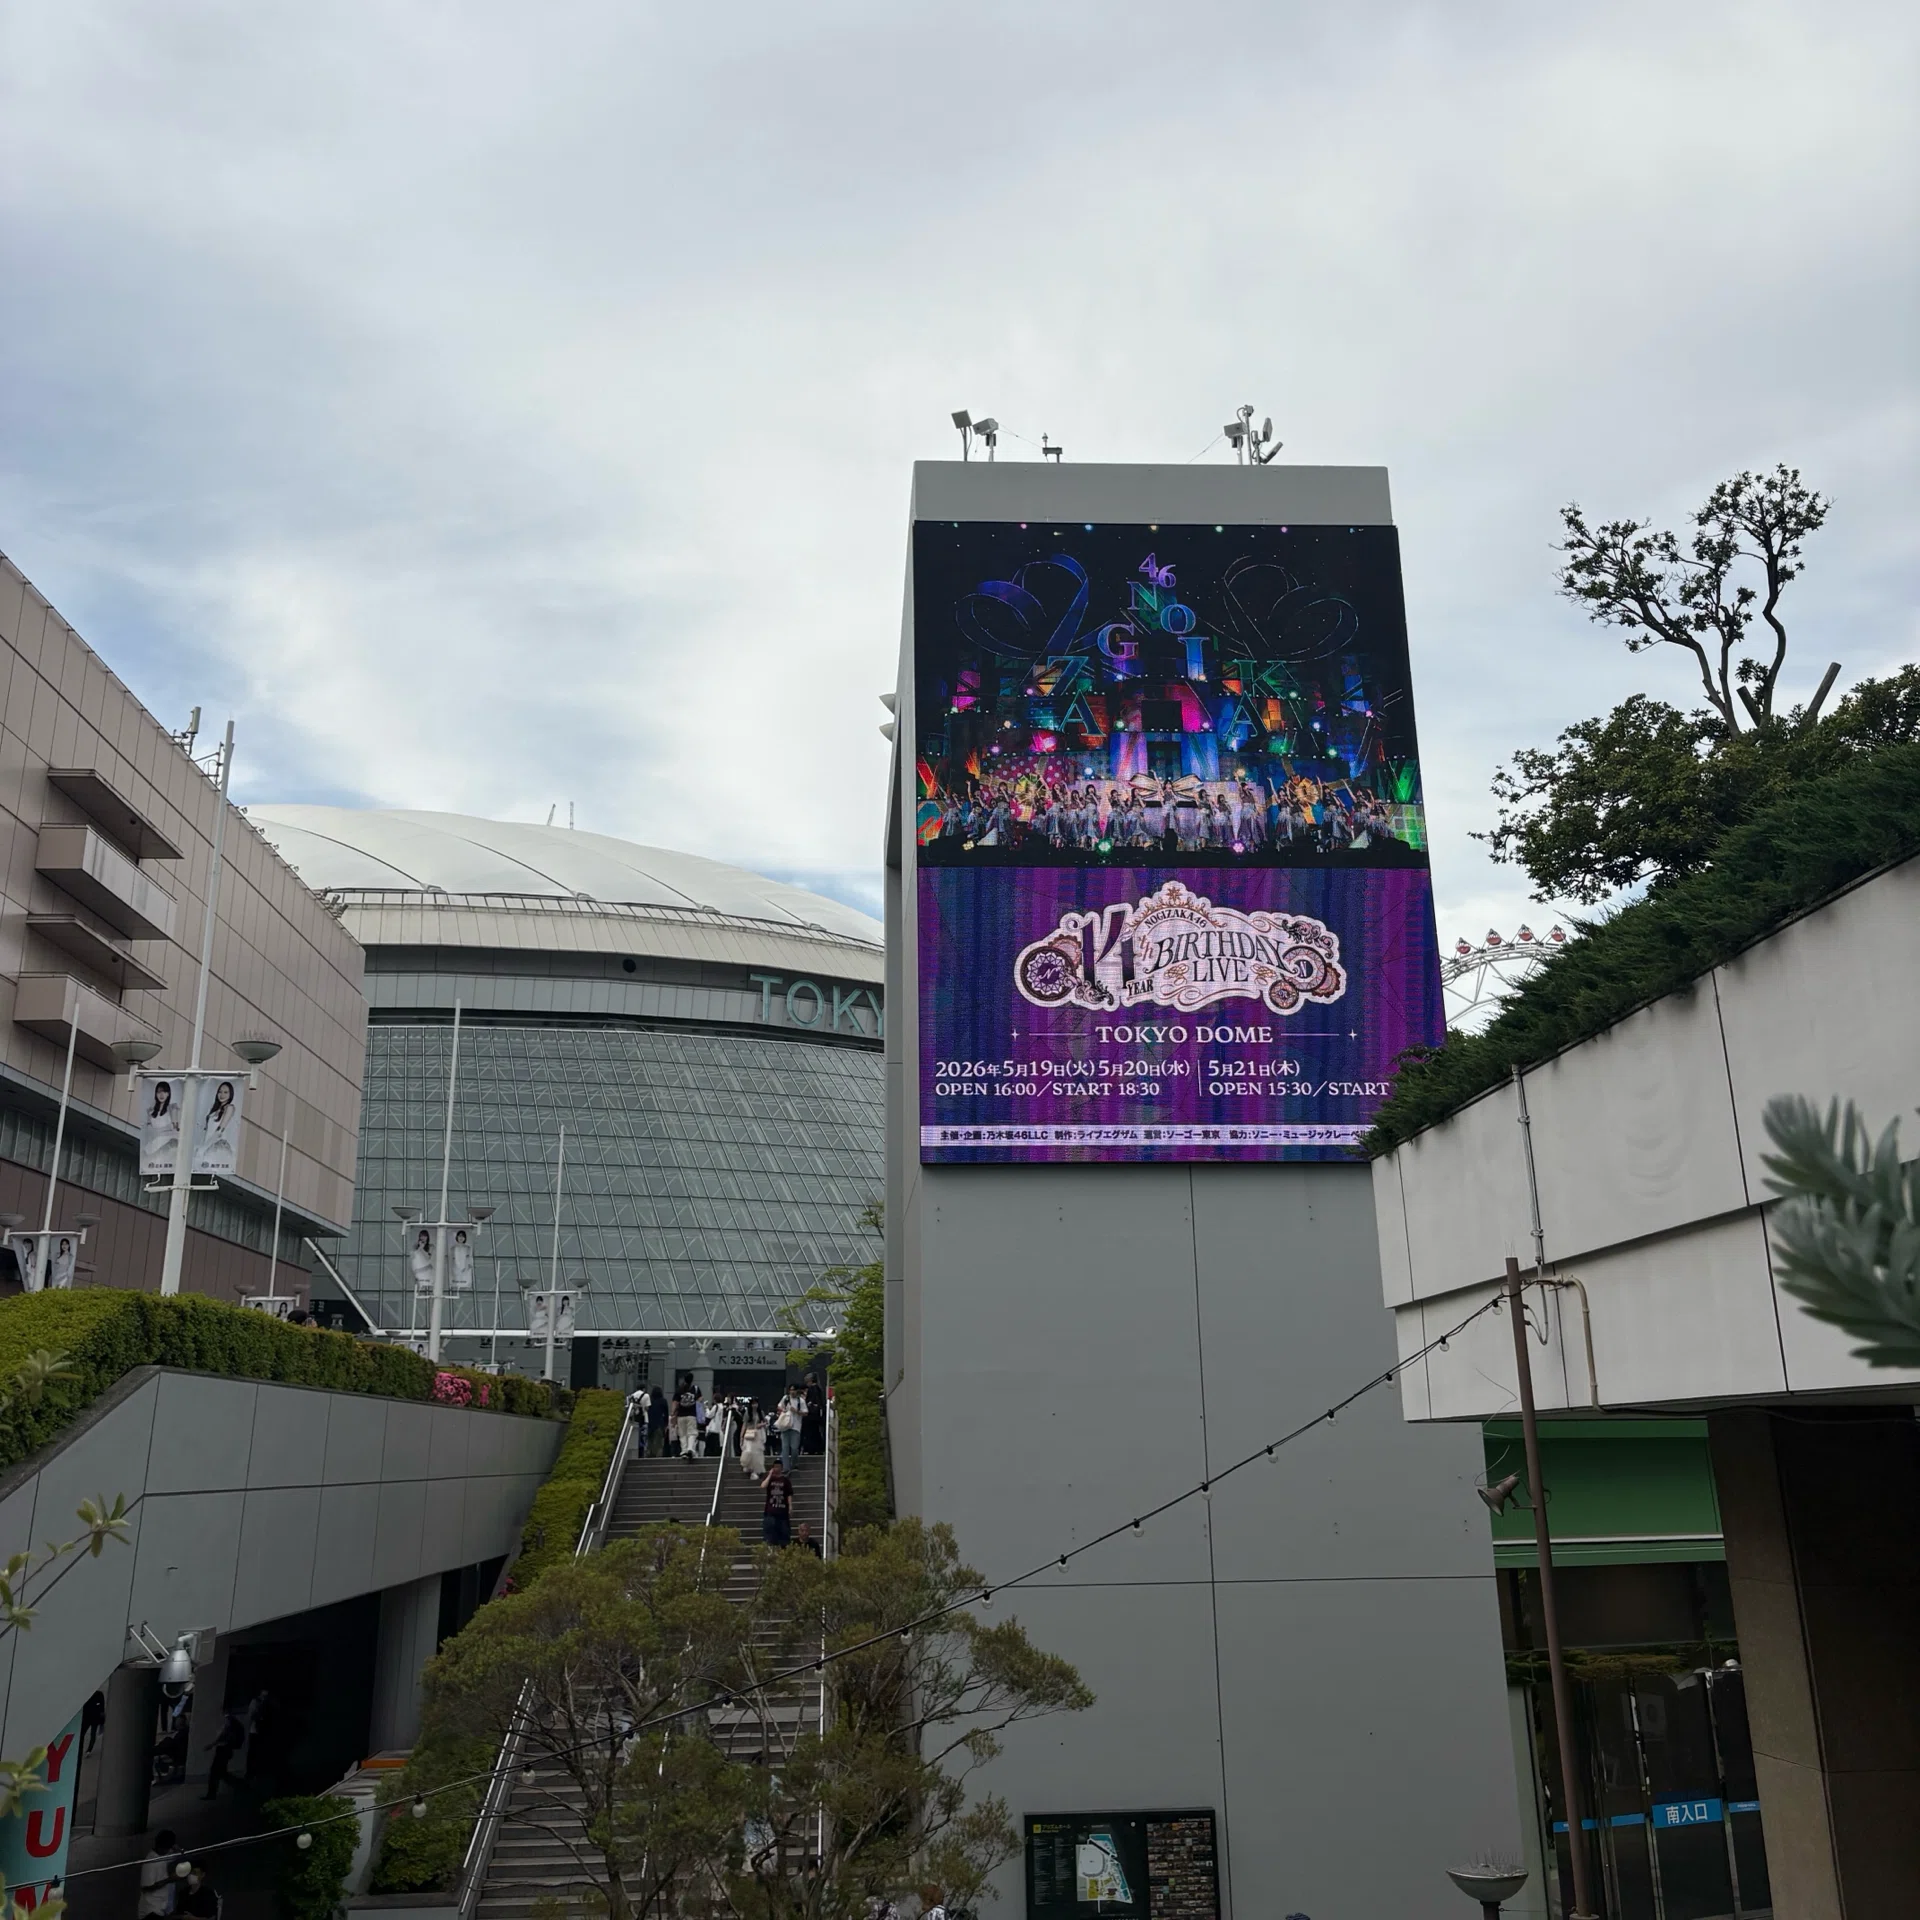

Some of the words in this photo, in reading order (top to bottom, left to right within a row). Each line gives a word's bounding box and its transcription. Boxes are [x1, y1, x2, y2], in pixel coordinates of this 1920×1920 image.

[1144, 909, 1208, 929] NOGIZAKA46
[1143, 930, 1299, 974] BIRTHDAY
[1192, 958, 1249, 982] LIVE
[1126, 979, 1154, 997] YEAR
[1095, 1025, 1188, 1043] TOKYO
[1195, 1025, 1274, 1043] DOME
[1207, 1059, 1300, 1077] 5月21日(木)
[935, 1082, 988, 1096] OPEN
[1119, 1082, 1160, 1096] 18:30
[1208, 1082, 1262, 1096] OPEN
[1665, 1802, 1708, 1825] 南入口
